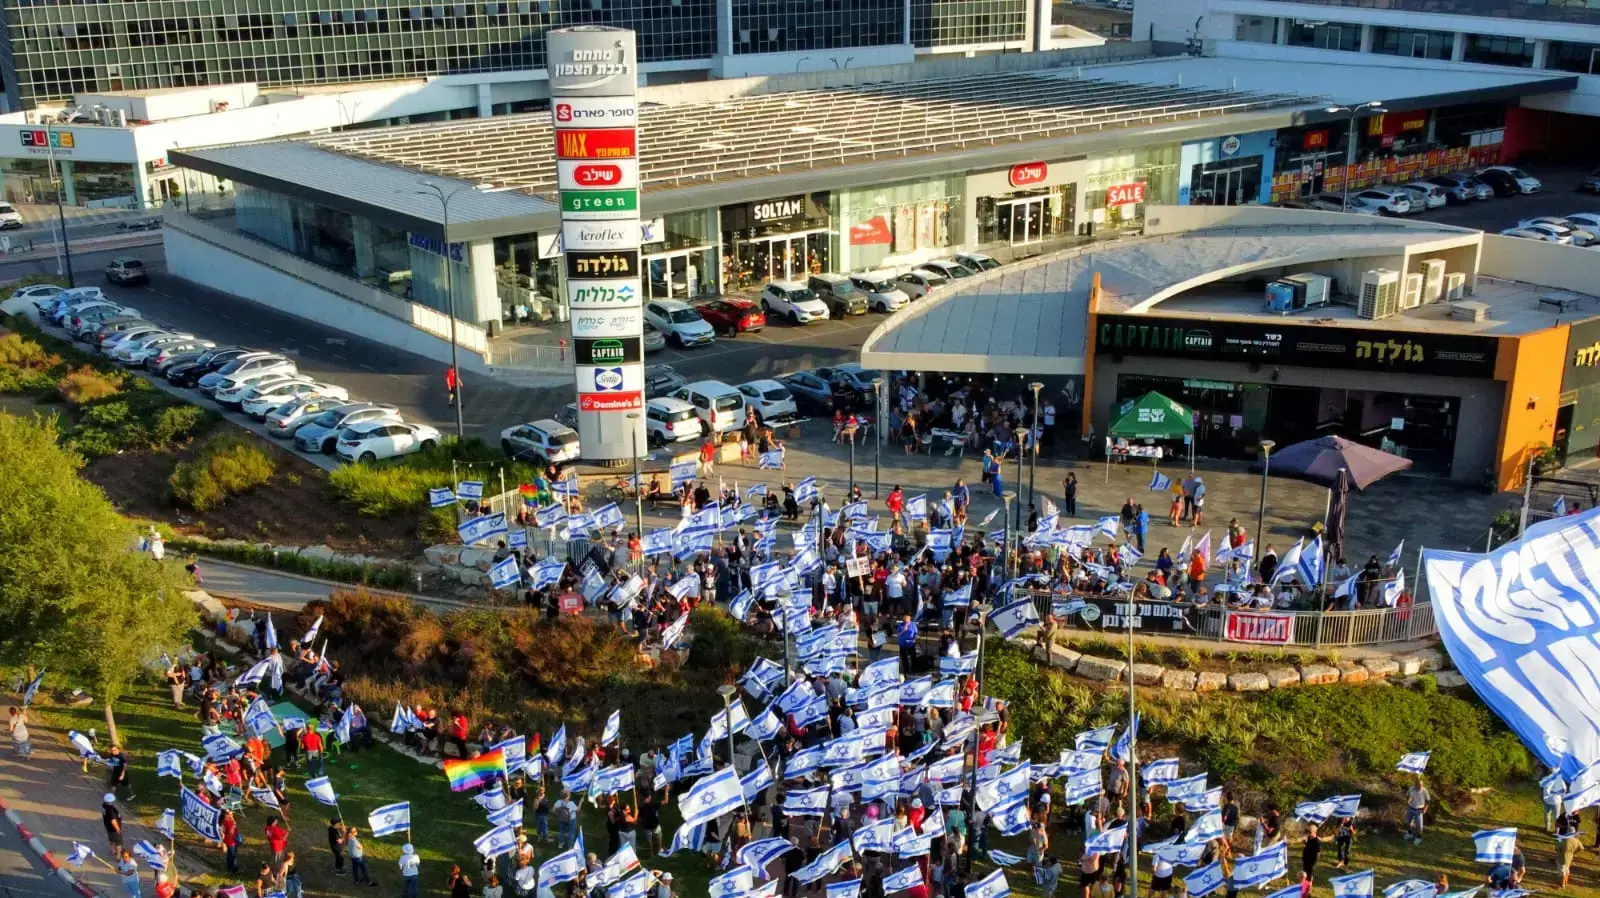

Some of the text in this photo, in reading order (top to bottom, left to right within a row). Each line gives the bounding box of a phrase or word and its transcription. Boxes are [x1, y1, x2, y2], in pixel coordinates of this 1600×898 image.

[573, 49, 613, 62] מתחם
[555, 63, 630, 77] רכבת הצפון
[562, 133, 587, 156] MAX
[582, 168, 614, 181] שילב
[1020, 167, 1042, 180] שילב
[1110, 187, 1141, 202] SALE
[573, 197, 625, 209] green
[754, 200, 800, 220] SOLTAM
[576, 229, 624, 241] Aeroflex
[574, 287, 615, 302] כללית
[1101, 323, 1184, 351] CAPTAIN
[1185, 336, 1213, 347] CAPTAIN
[592, 348, 624, 357] CAPTAIN
[594, 399, 633, 410] Domino's
